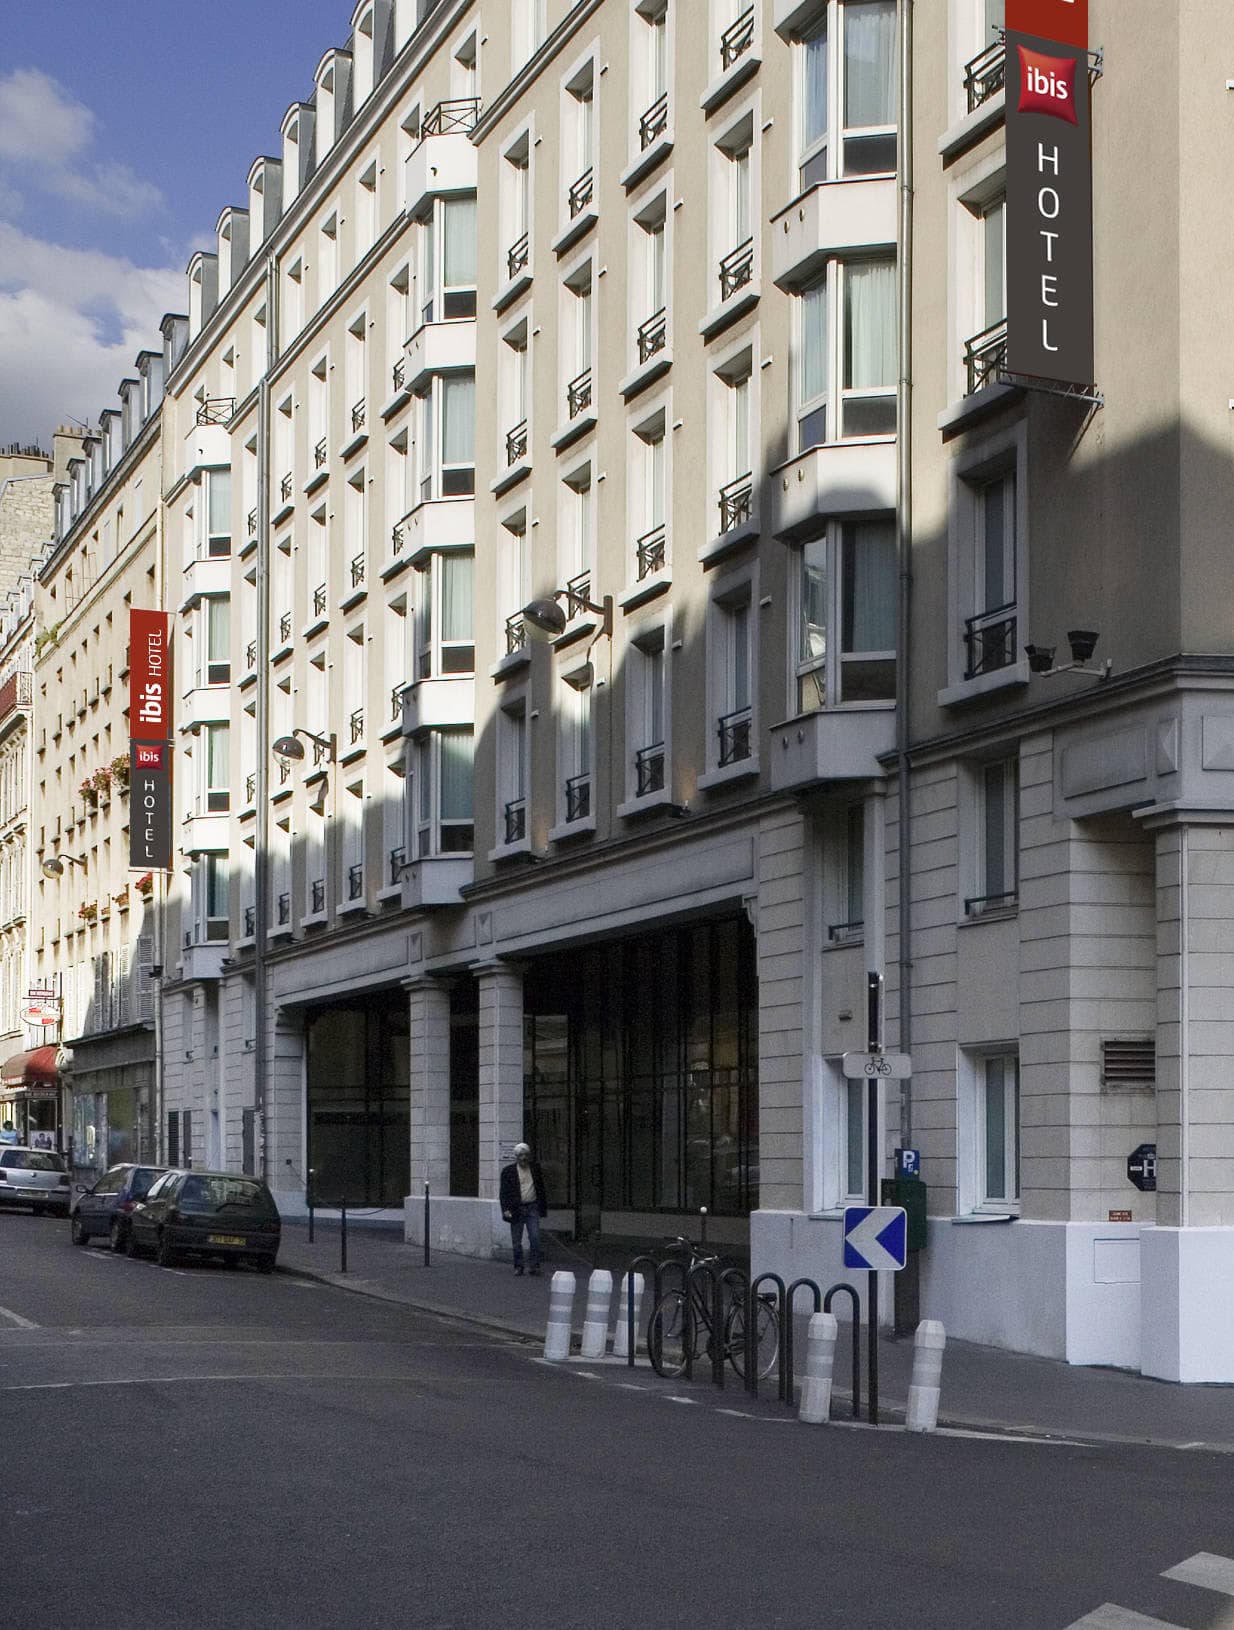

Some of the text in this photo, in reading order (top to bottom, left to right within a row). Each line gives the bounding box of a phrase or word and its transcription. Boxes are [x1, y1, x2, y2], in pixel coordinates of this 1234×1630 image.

[1027, 67, 1068, 100] ibis
[1038, 143, 1060, 352] HOTEL
[139, 629, 162, 723] ibis HOTEL
[139, 750, 159, 762] ibis
[144, 779, 155, 858] HOTEL
[903, 1150, 915, 1168] P
